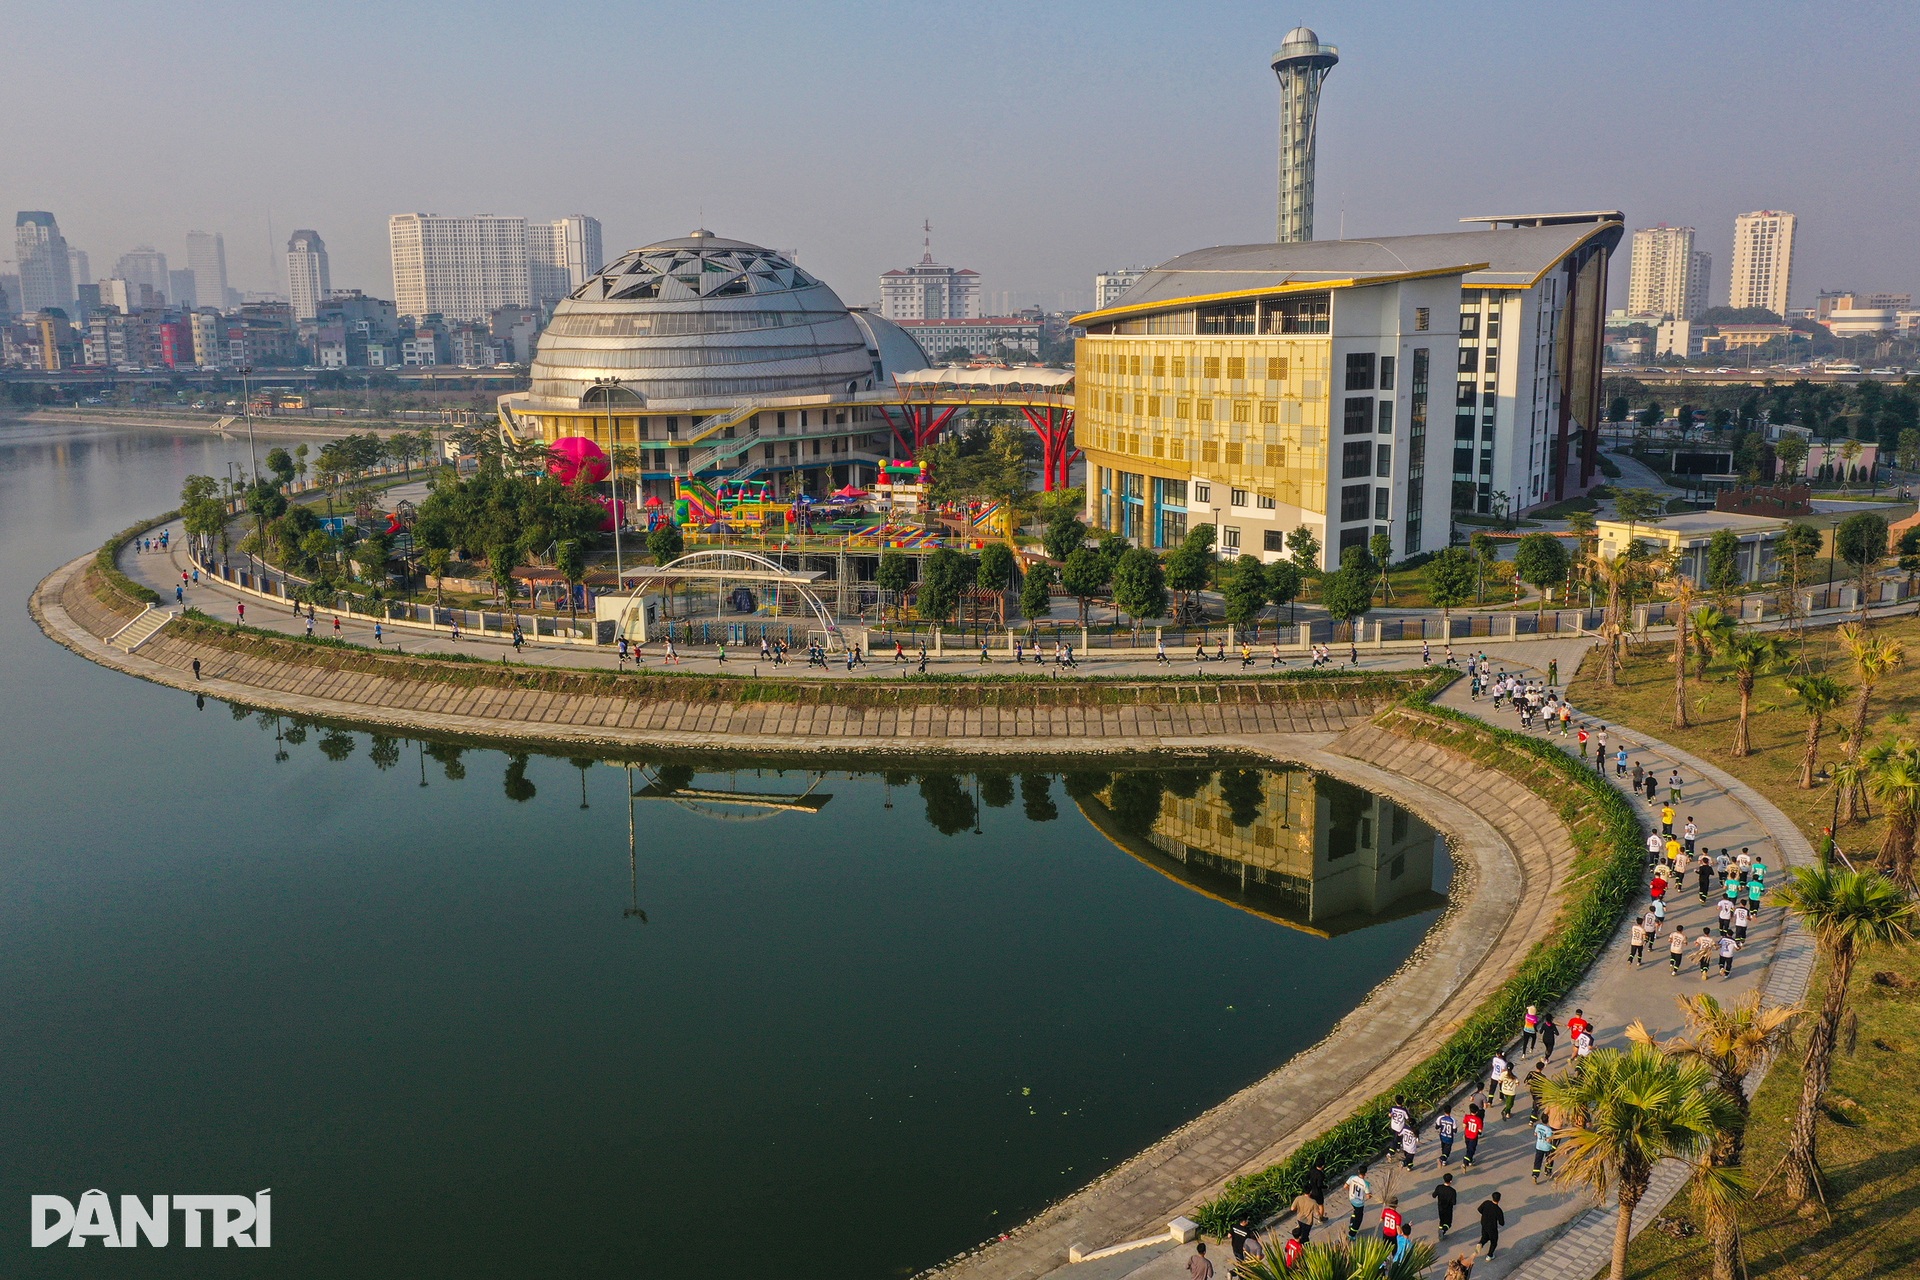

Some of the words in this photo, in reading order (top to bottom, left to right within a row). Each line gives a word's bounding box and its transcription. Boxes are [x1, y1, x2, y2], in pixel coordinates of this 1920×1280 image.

[1467, 1121, 1477, 1133] 10
[1352, 1184, 1362, 1197] 14
[1384, 1216, 1396, 1230] 68
